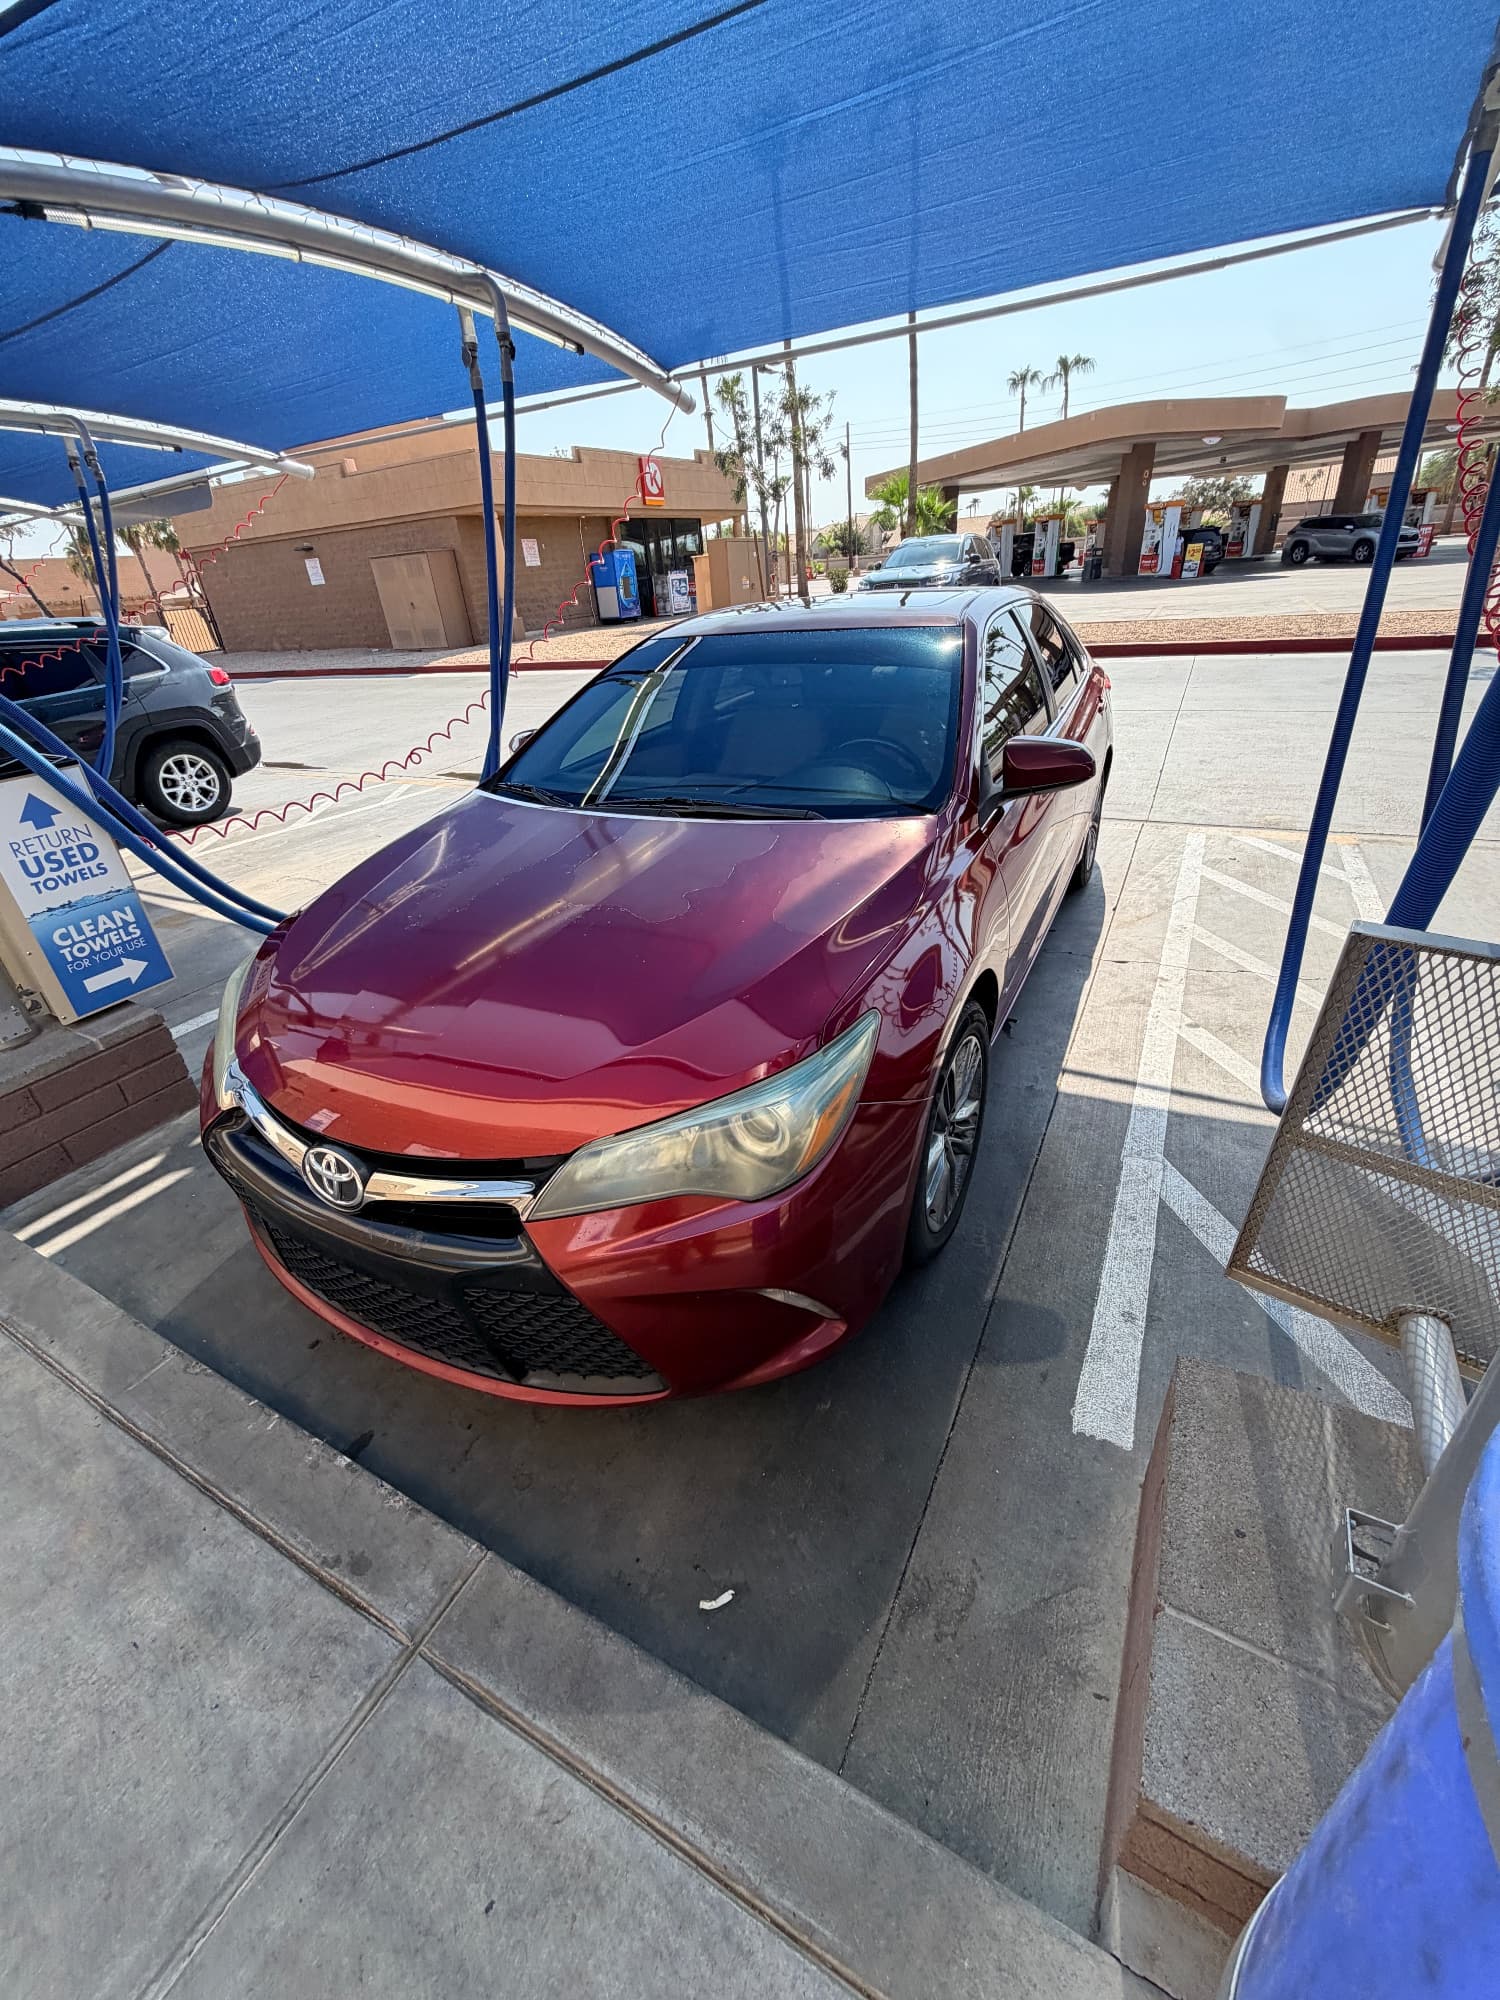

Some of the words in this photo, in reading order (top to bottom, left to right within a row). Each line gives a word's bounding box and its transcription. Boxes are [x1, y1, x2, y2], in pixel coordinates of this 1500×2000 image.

[9, 823, 93, 858] RETURN
[18, 842, 99, 878] USED
[30, 862, 108, 894] TOWELS
[53, 906, 136, 946] CLEAN
[59, 924, 141, 961] TOWELS
[67, 959, 92, 973] FOR
[92, 946, 125, 962] YOUR
[126, 937, 147, 950] USE
